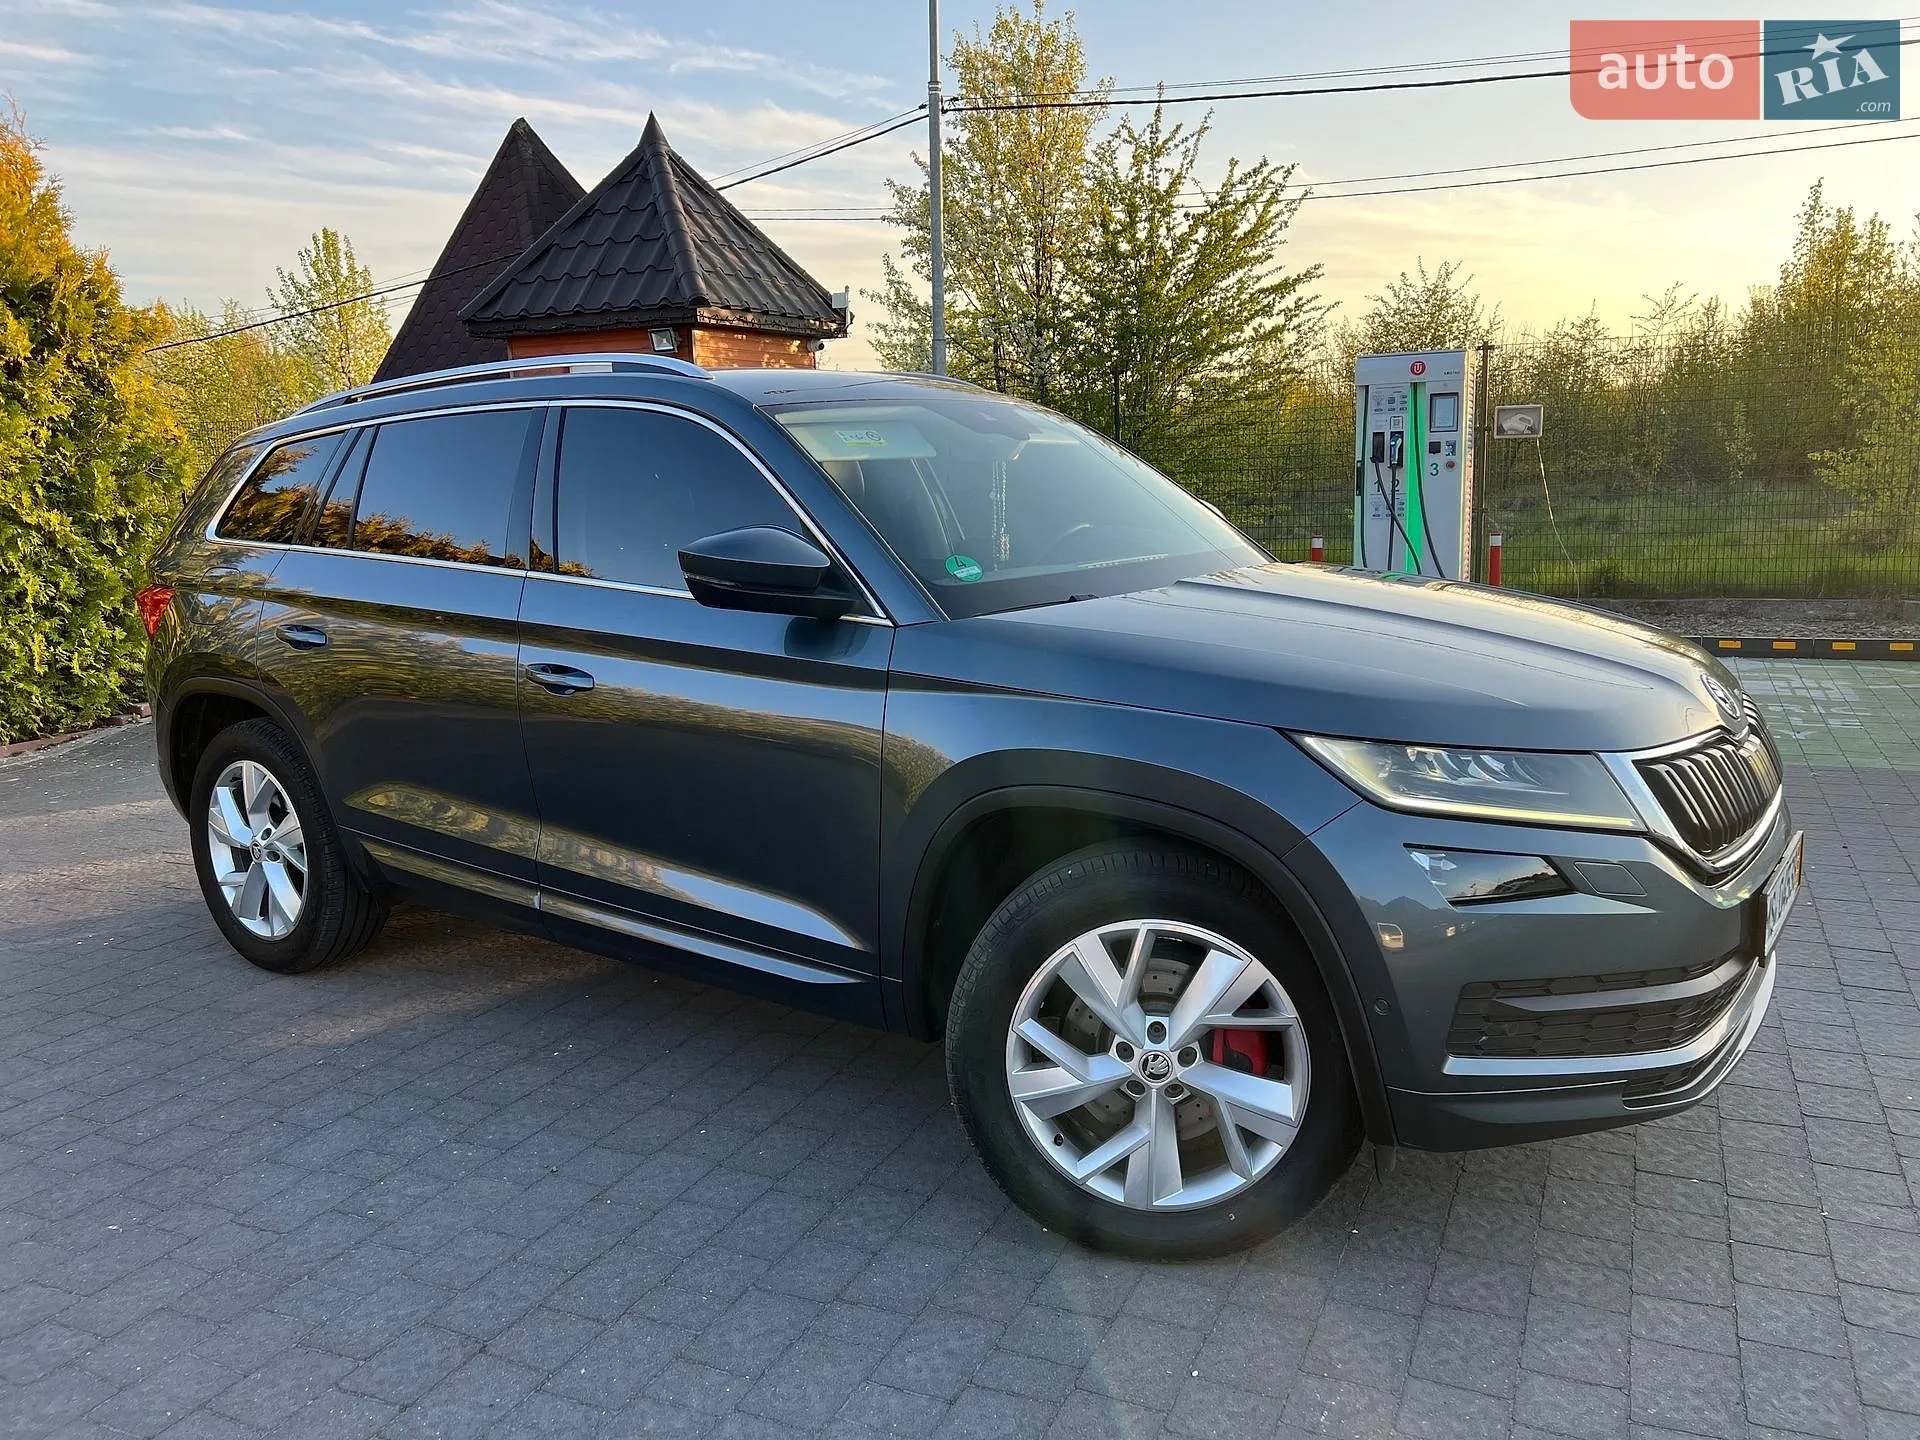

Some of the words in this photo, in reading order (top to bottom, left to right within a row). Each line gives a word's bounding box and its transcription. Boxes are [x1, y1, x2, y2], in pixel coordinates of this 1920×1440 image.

[1430, 462, 1439, 476] 3
[1391, 479, 1400, 492] 2
[954, 556, 967, 568] 4
